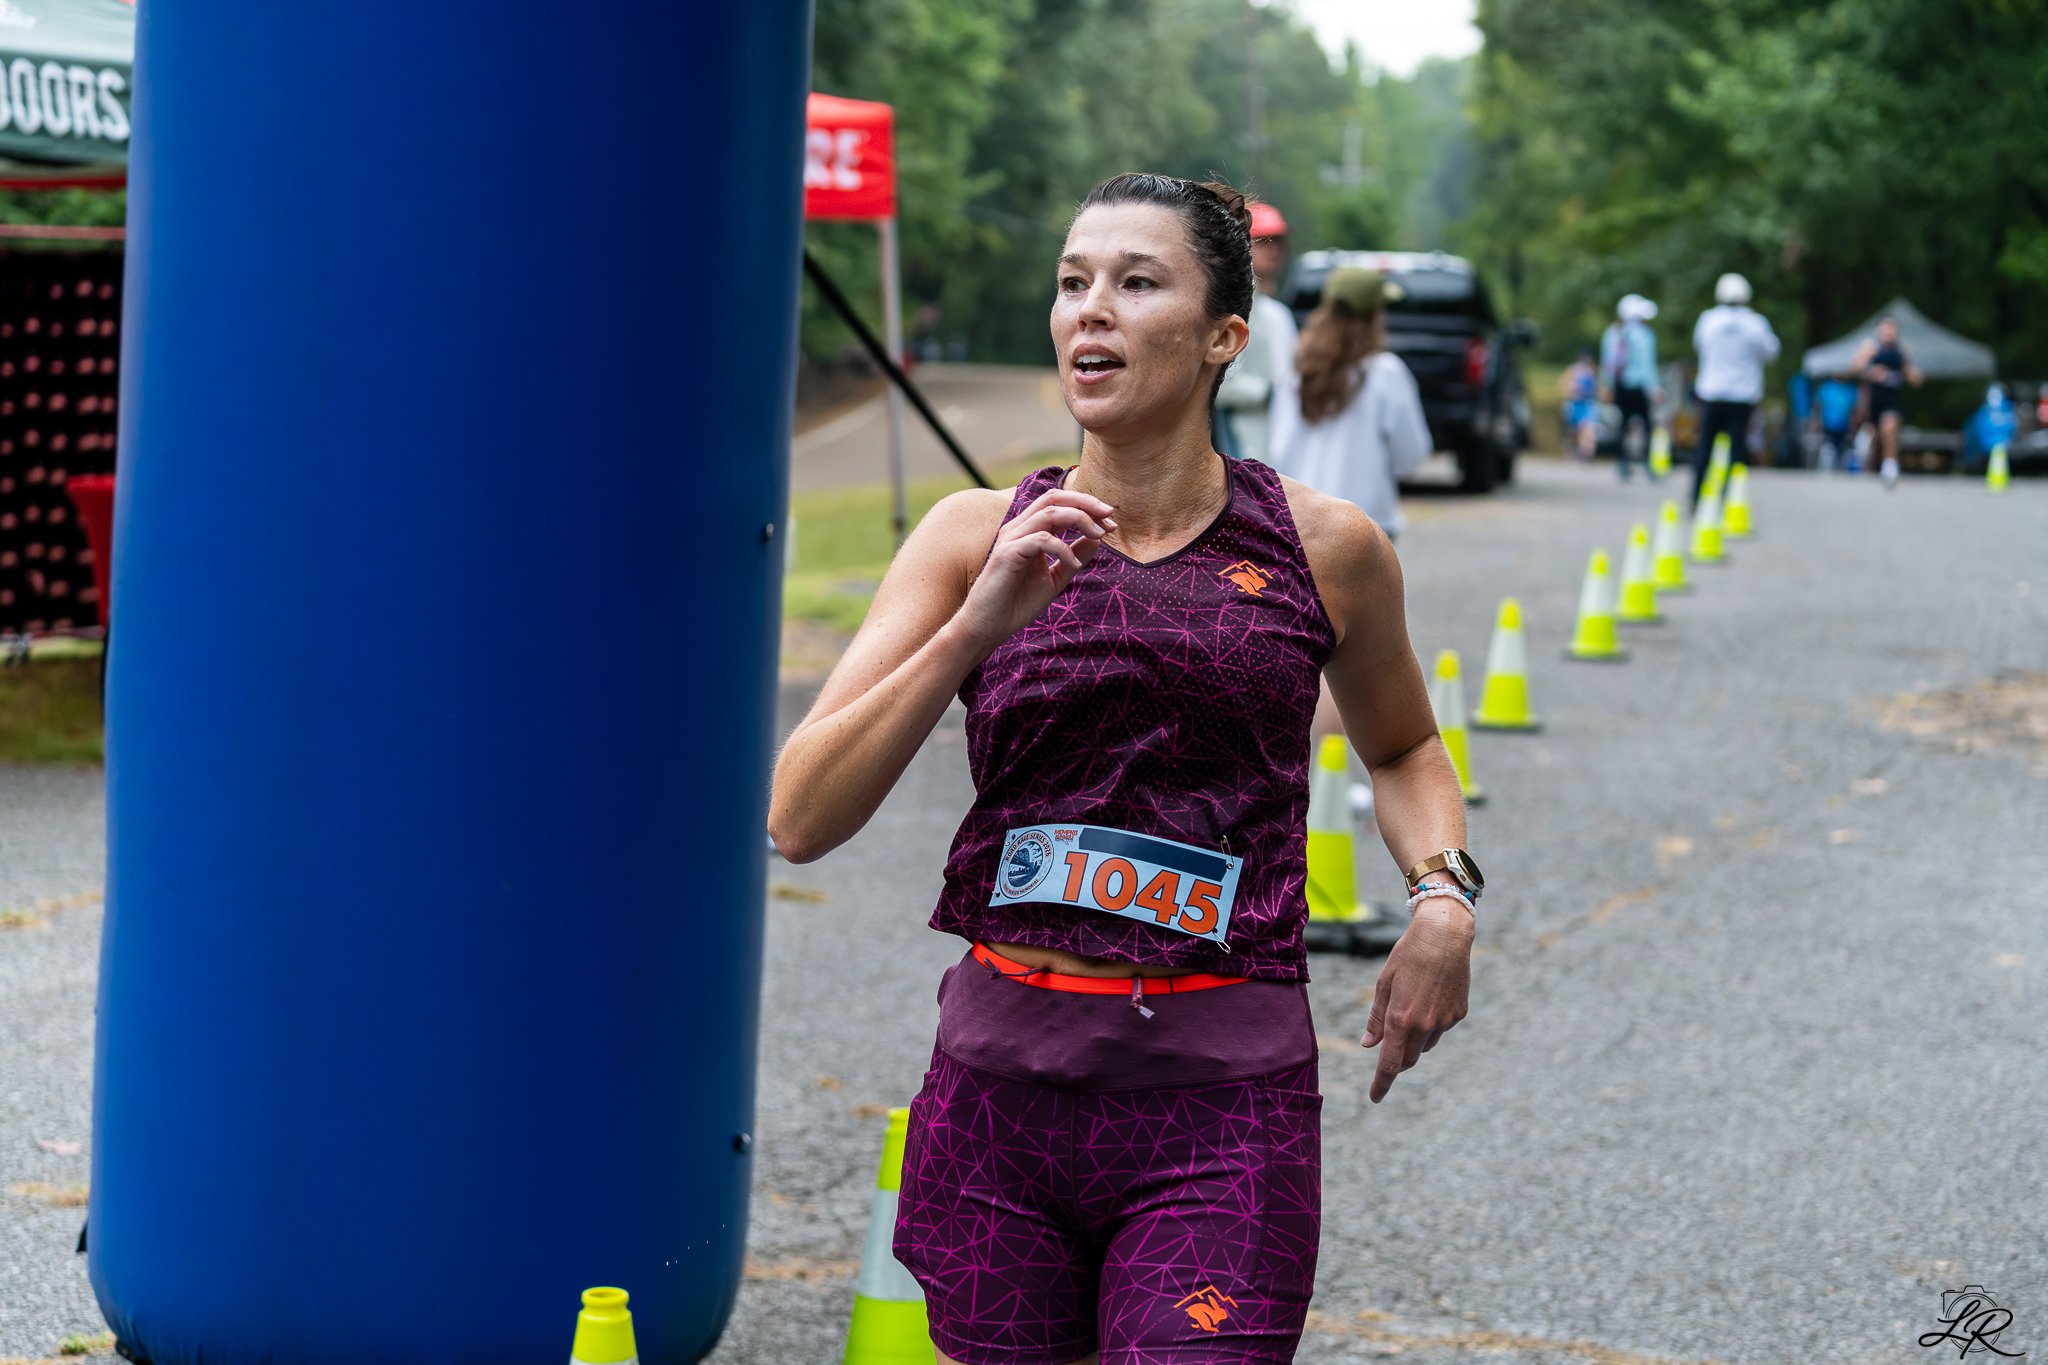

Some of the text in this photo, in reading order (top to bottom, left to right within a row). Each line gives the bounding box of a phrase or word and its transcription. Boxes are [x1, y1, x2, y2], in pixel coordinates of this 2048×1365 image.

[1005, 844, 1018, 861] ROAD
[1017, 834, 1030, 846] RACE
[1030, 832, 1046, 844] SERIES
[1062, 851, 1223, 935] 1045
